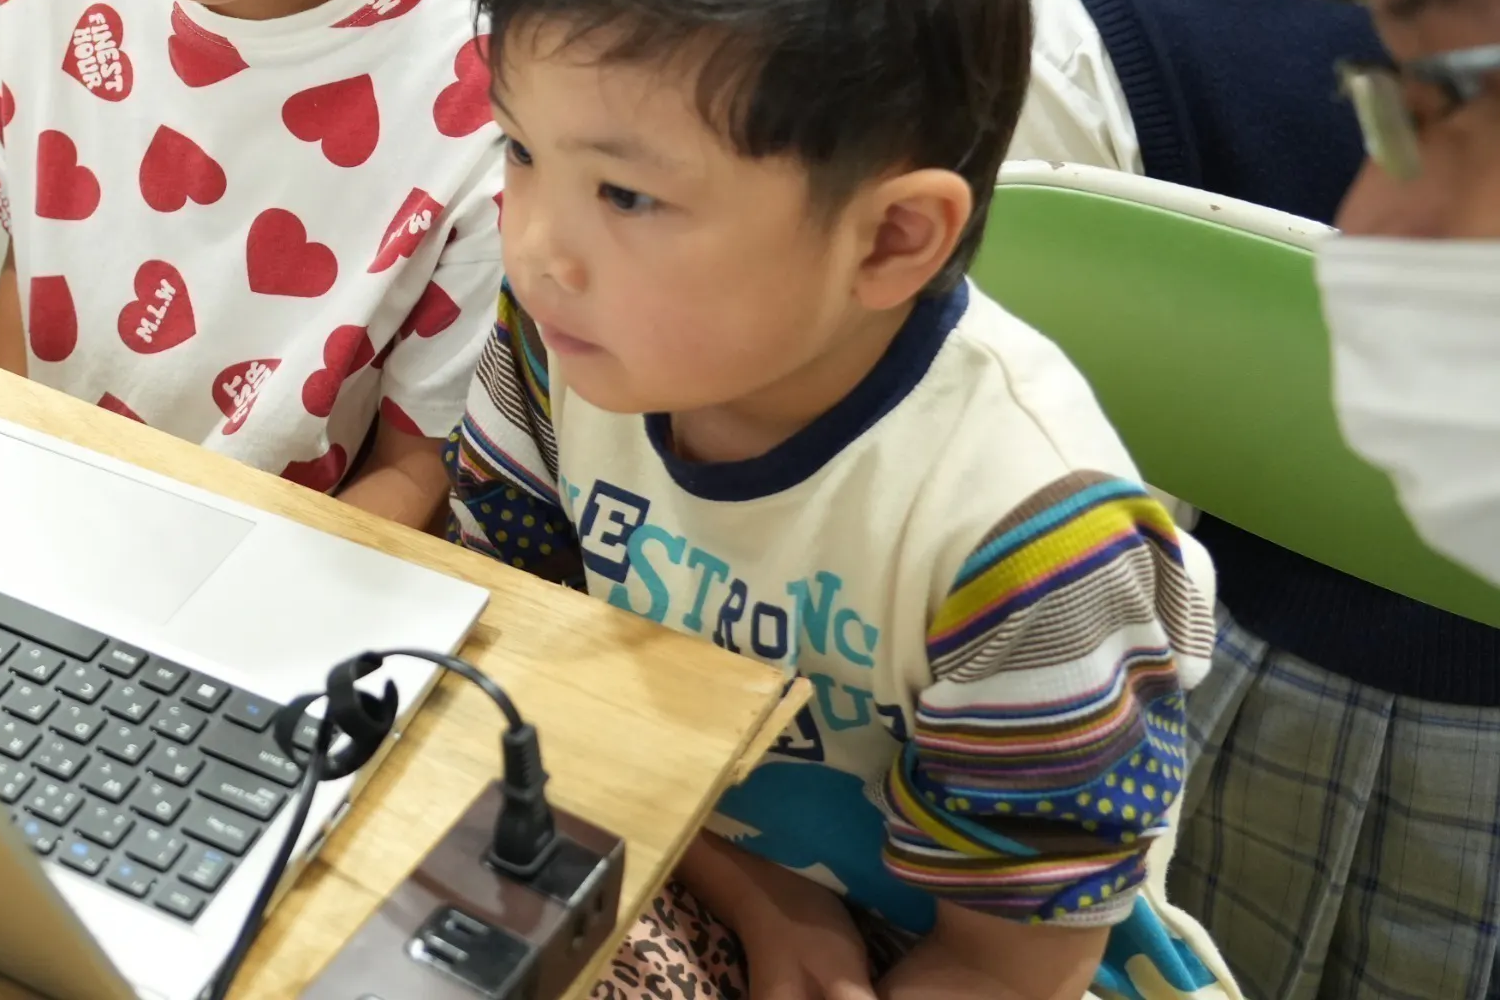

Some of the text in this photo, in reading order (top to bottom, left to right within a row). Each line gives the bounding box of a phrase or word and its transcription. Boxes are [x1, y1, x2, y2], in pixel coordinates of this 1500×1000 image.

[73, 27, 102, 90] HOUR
[88, 12, 123, 92] FINEST
[33, 664, 46, 676] V
[80, 683, 94, 695] C
[28, 704, 42, 715] F
[127, 703, 142, 715] X
[74, 722, 89, 735] D
[175, 723, 191, 735] Z
[9, 738, 23, 751] R
[124, 743, 138, 756] S
[59, 758, 74, 772] E
[174, 763, 189, 776] A
[103, 779, 121, 793] W
